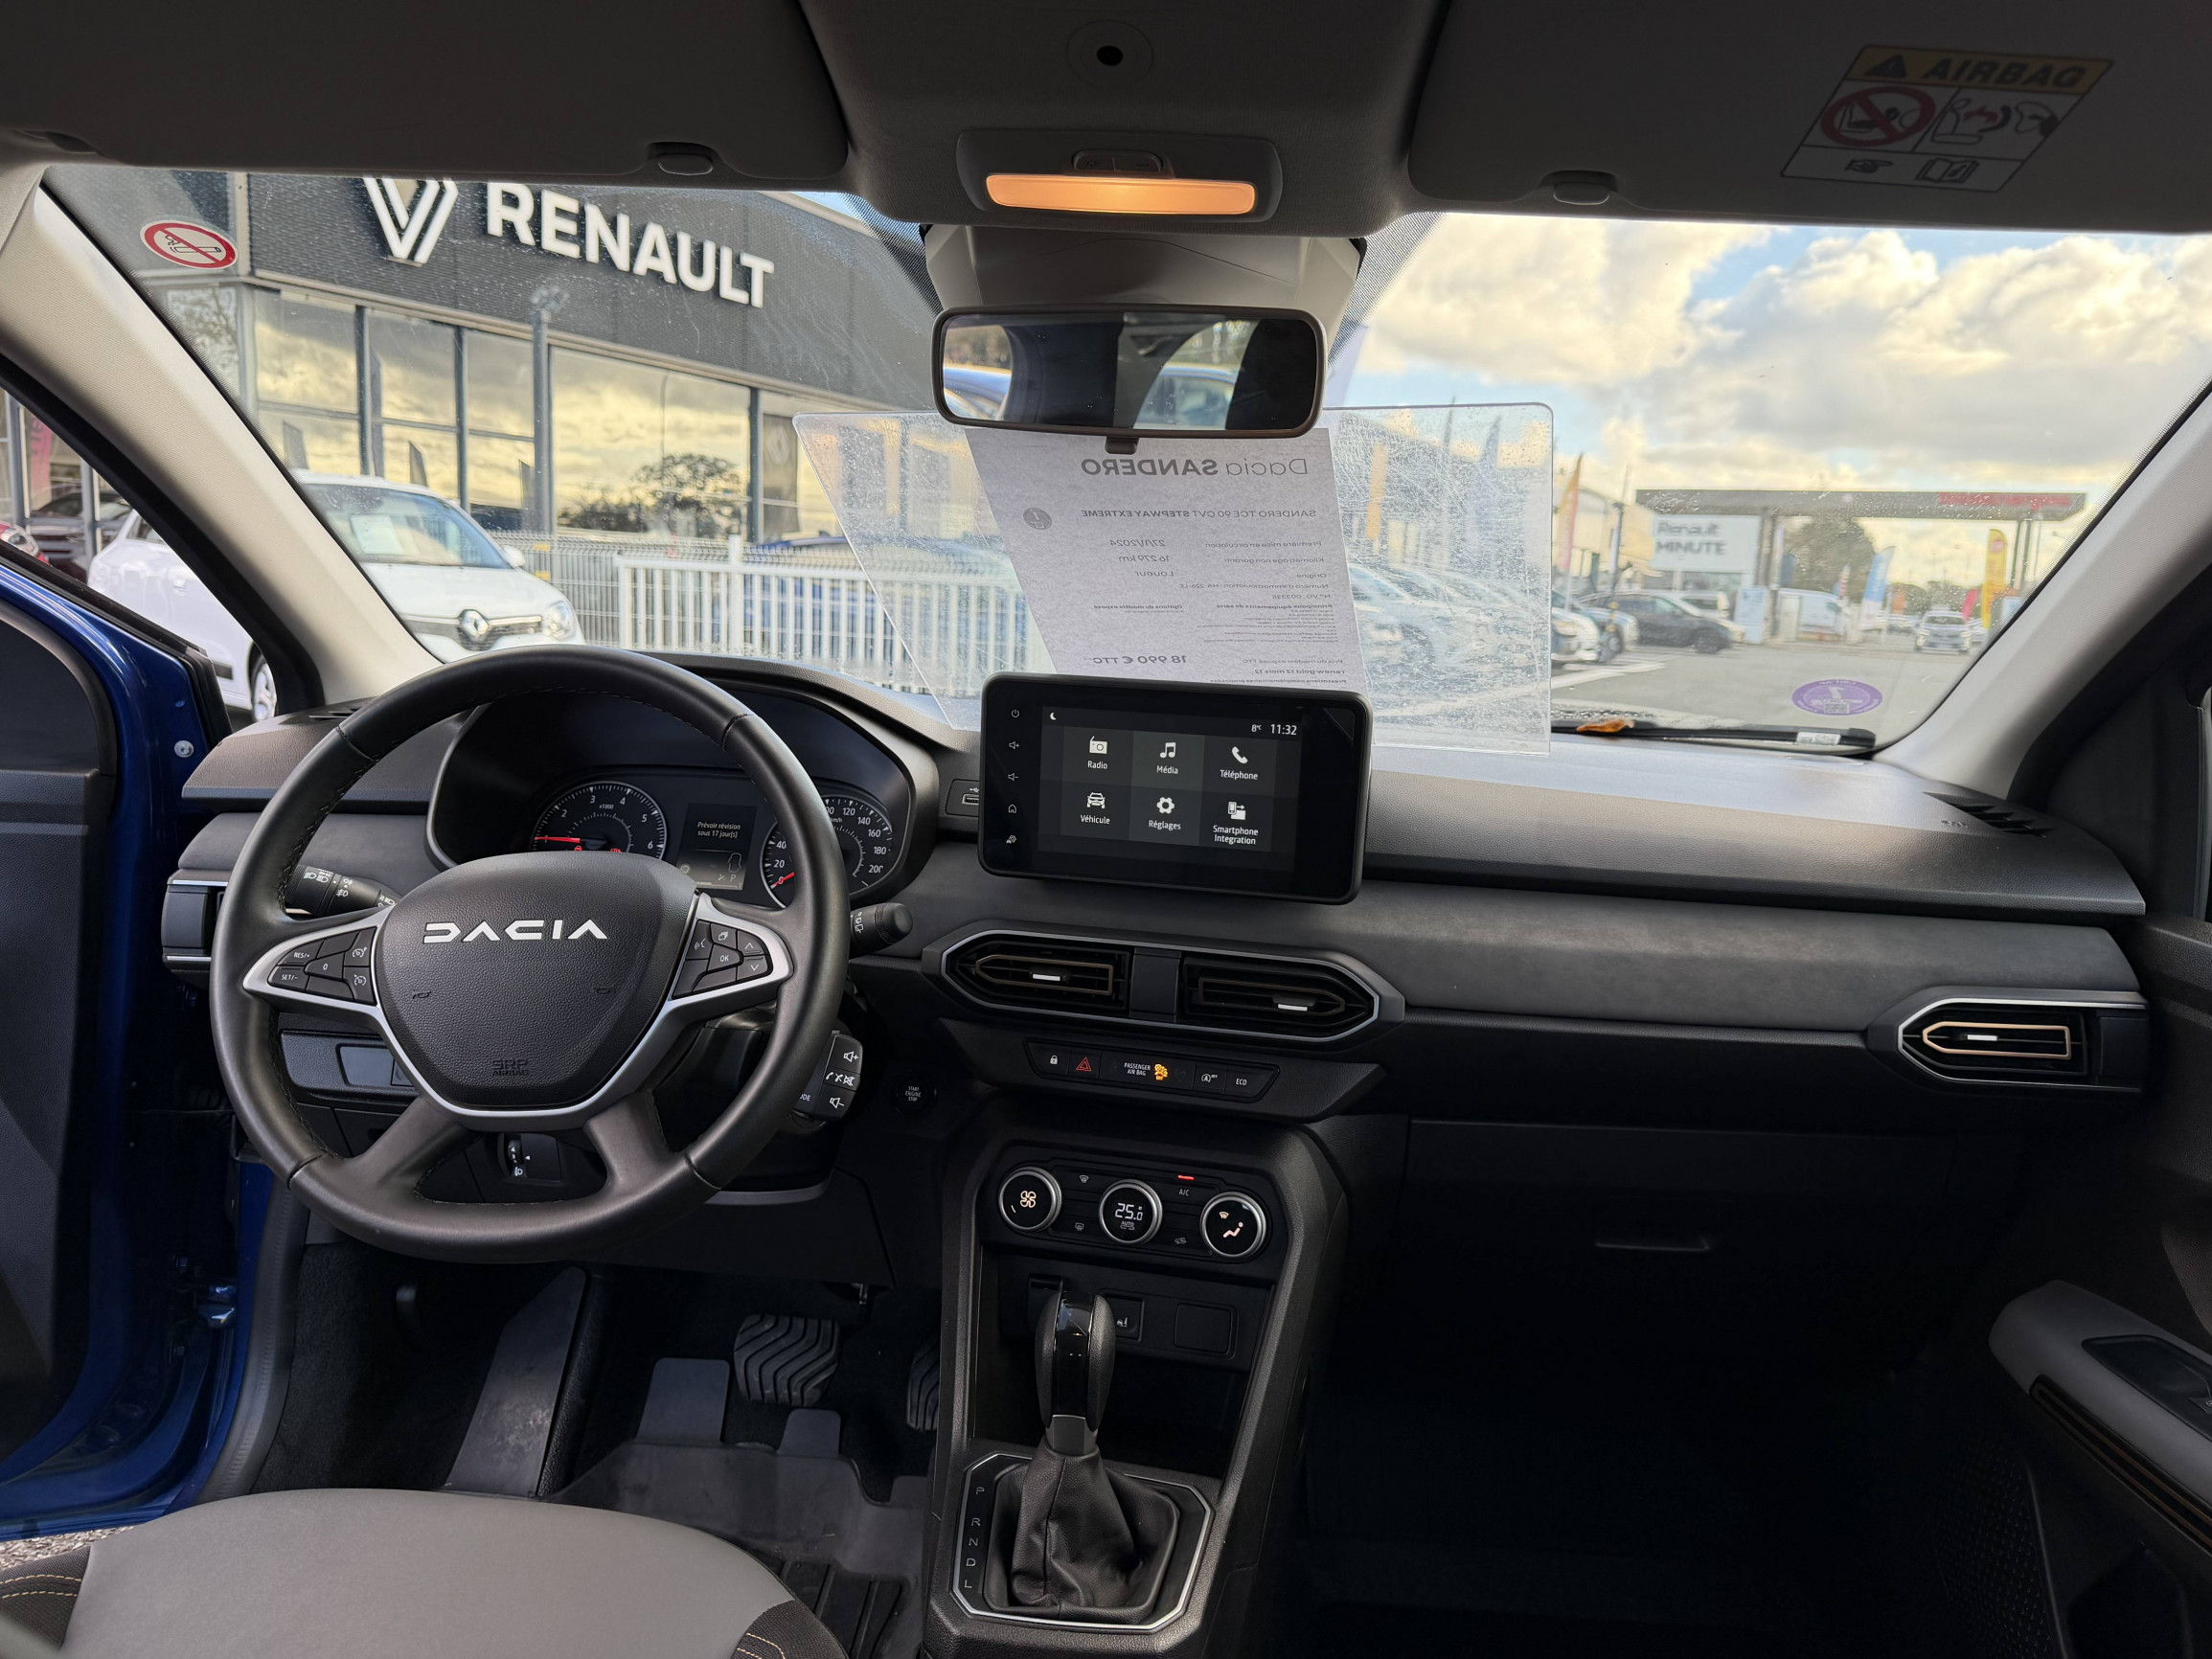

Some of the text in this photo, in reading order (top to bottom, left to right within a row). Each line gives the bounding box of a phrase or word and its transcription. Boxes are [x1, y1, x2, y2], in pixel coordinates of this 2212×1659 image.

[1923, 57, 2087, 87] AIRBAG
[487, 182, 774, 308] RENAULT
[1270, 724, 1298, 735] 11:32
[1087, 760, 1108, 769] Radio
[1157, 765, 1179, 774] Média
[1220, 769, 1258, 780] Téléphone
[590, 795, 596, 803] 3
[620, 797, 626, 805] 4
[561, 809, 568, 818] 2
[843, 807, 856, 816] 120
[642, 814, 648, 823] 5
[857, 816, 871, 825] 140
[1080, 815, 1110, 824] Véhicule
[1148, 819, 1181, 831] Réglages
[719, 831, 738, 839] jour(s)
[868, 829, 881, 838] 160
[1212, 825, 1258, 836] Smartphone
[1214, 834, 1256, 845] Integration
[648, 841, 653, 849] 6
[776, 841, 787, 850] 40
[873, 846, 887, 855] 180
[774, 860, 785, 868] 20
[423, 919, 608, 943] DACIA
[1124, 1062, 1151, 1070] PASSENGER
[1178, 1188, 1190, 1196] A/C
[976, 1487, 985, 1495] P
[971, 1517, 981, 1527] R
[968, 1537, 979, 1546] N
[965, 1558, 976, 1567] D
[964, 1579, 972, 1589] L
